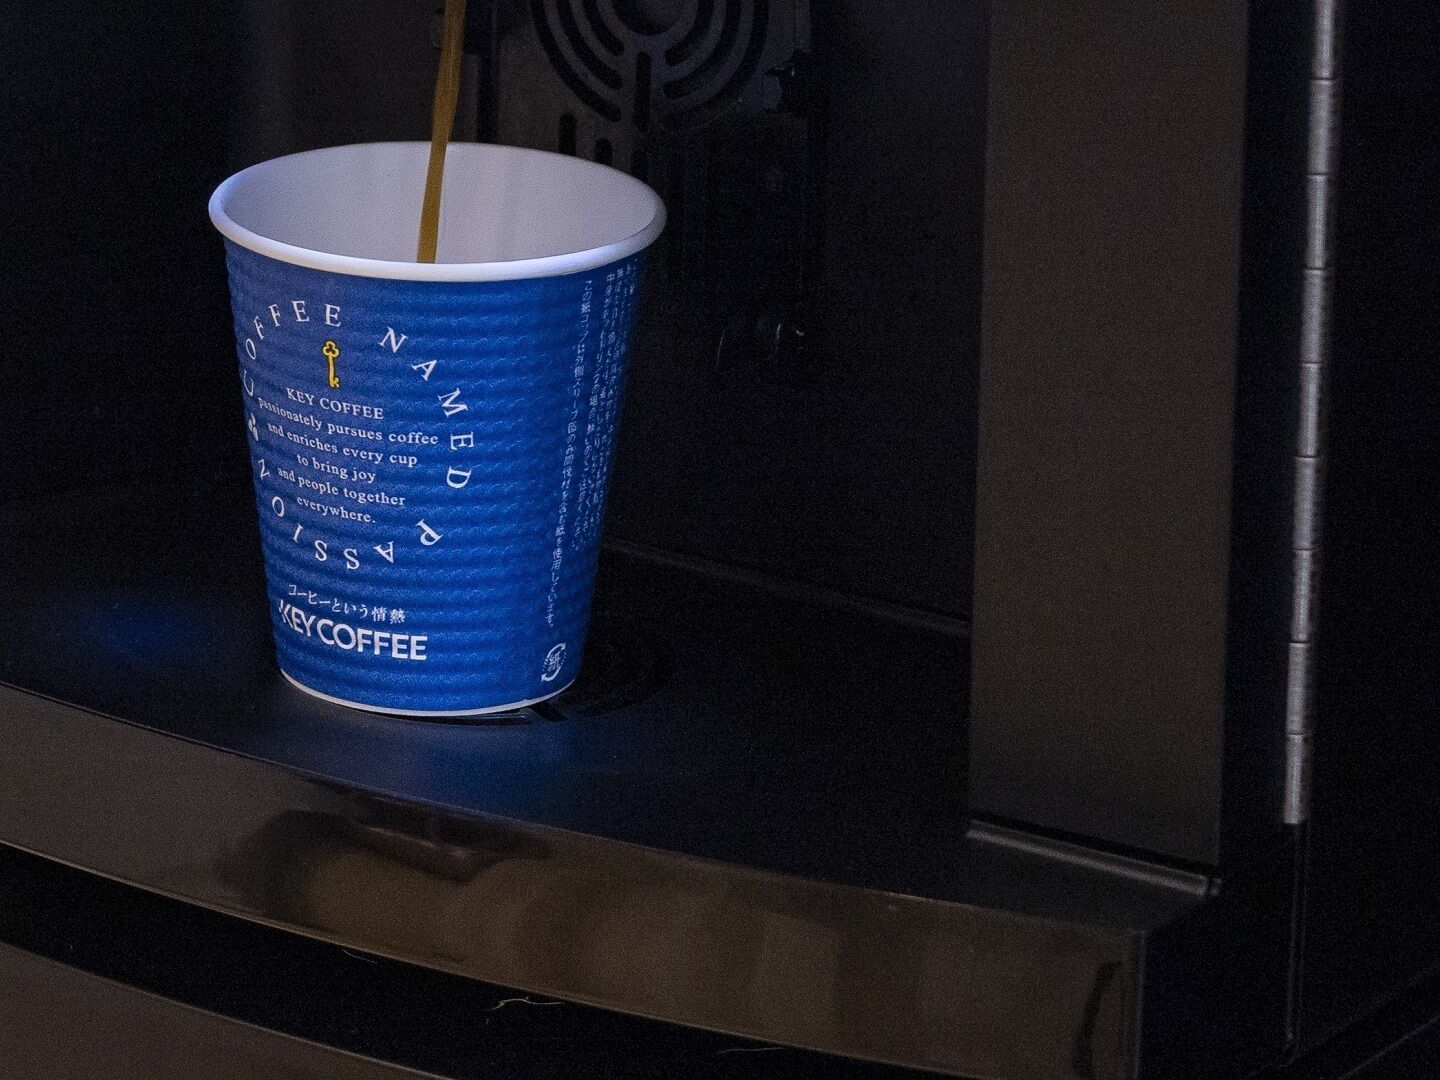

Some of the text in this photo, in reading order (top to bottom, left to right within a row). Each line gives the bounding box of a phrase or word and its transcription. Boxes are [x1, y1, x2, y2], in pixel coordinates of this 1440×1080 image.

[258, 396, 439, 445] passionately pursues coffee
[286, 387, 384, 420] KEY COFFEE
[267, 422, 418, 468] and enriches every cup
[277, 466, 406, 506] and people together
[296, 453, 376, 483] to bring joy
[296, 495, 376, 524] everywhere.
[288, 584, 406, 624] コーヒーという情熱
